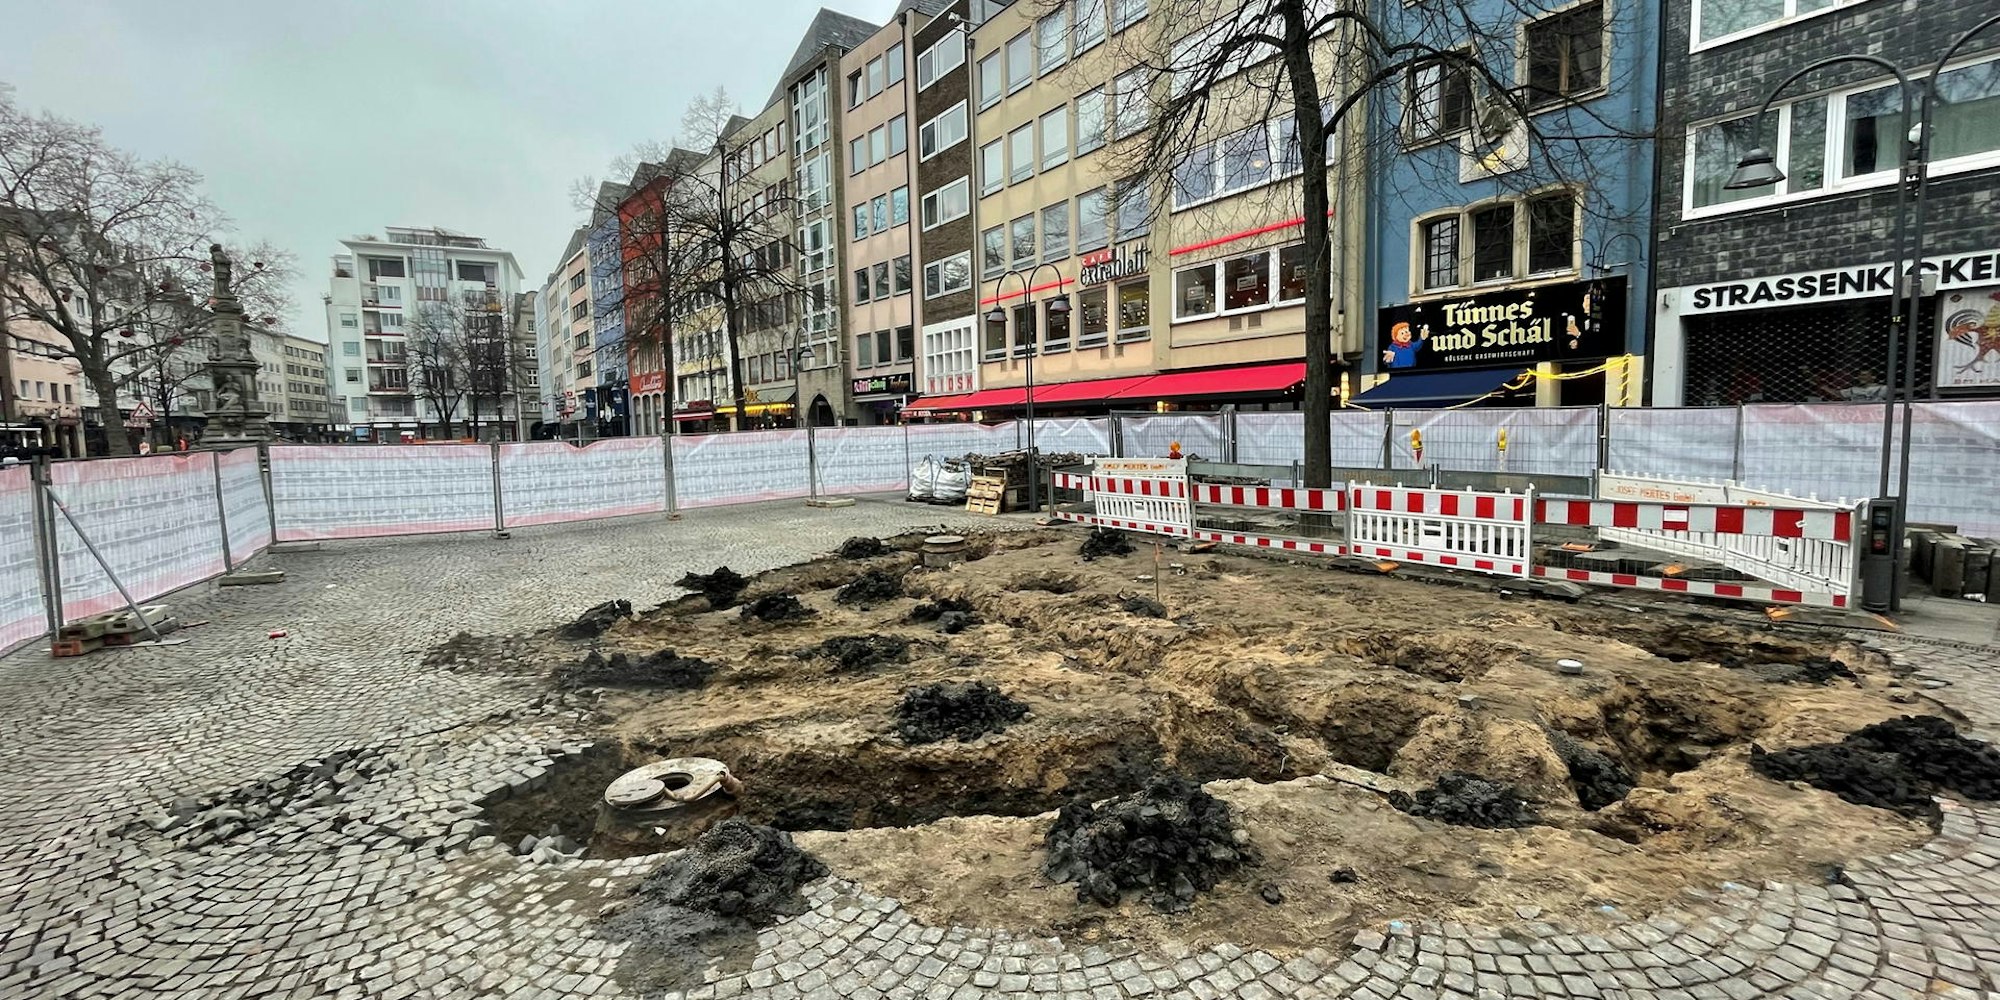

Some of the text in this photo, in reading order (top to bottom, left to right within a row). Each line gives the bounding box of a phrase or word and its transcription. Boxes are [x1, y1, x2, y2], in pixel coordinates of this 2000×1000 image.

[1081, 241, 1151, 287] extrablatt
[1442, 299, 1535, 327] Tünnes
[1431, 317, 1553, 352] und Schäl
[928, 373, 973, 393] KIOSK
